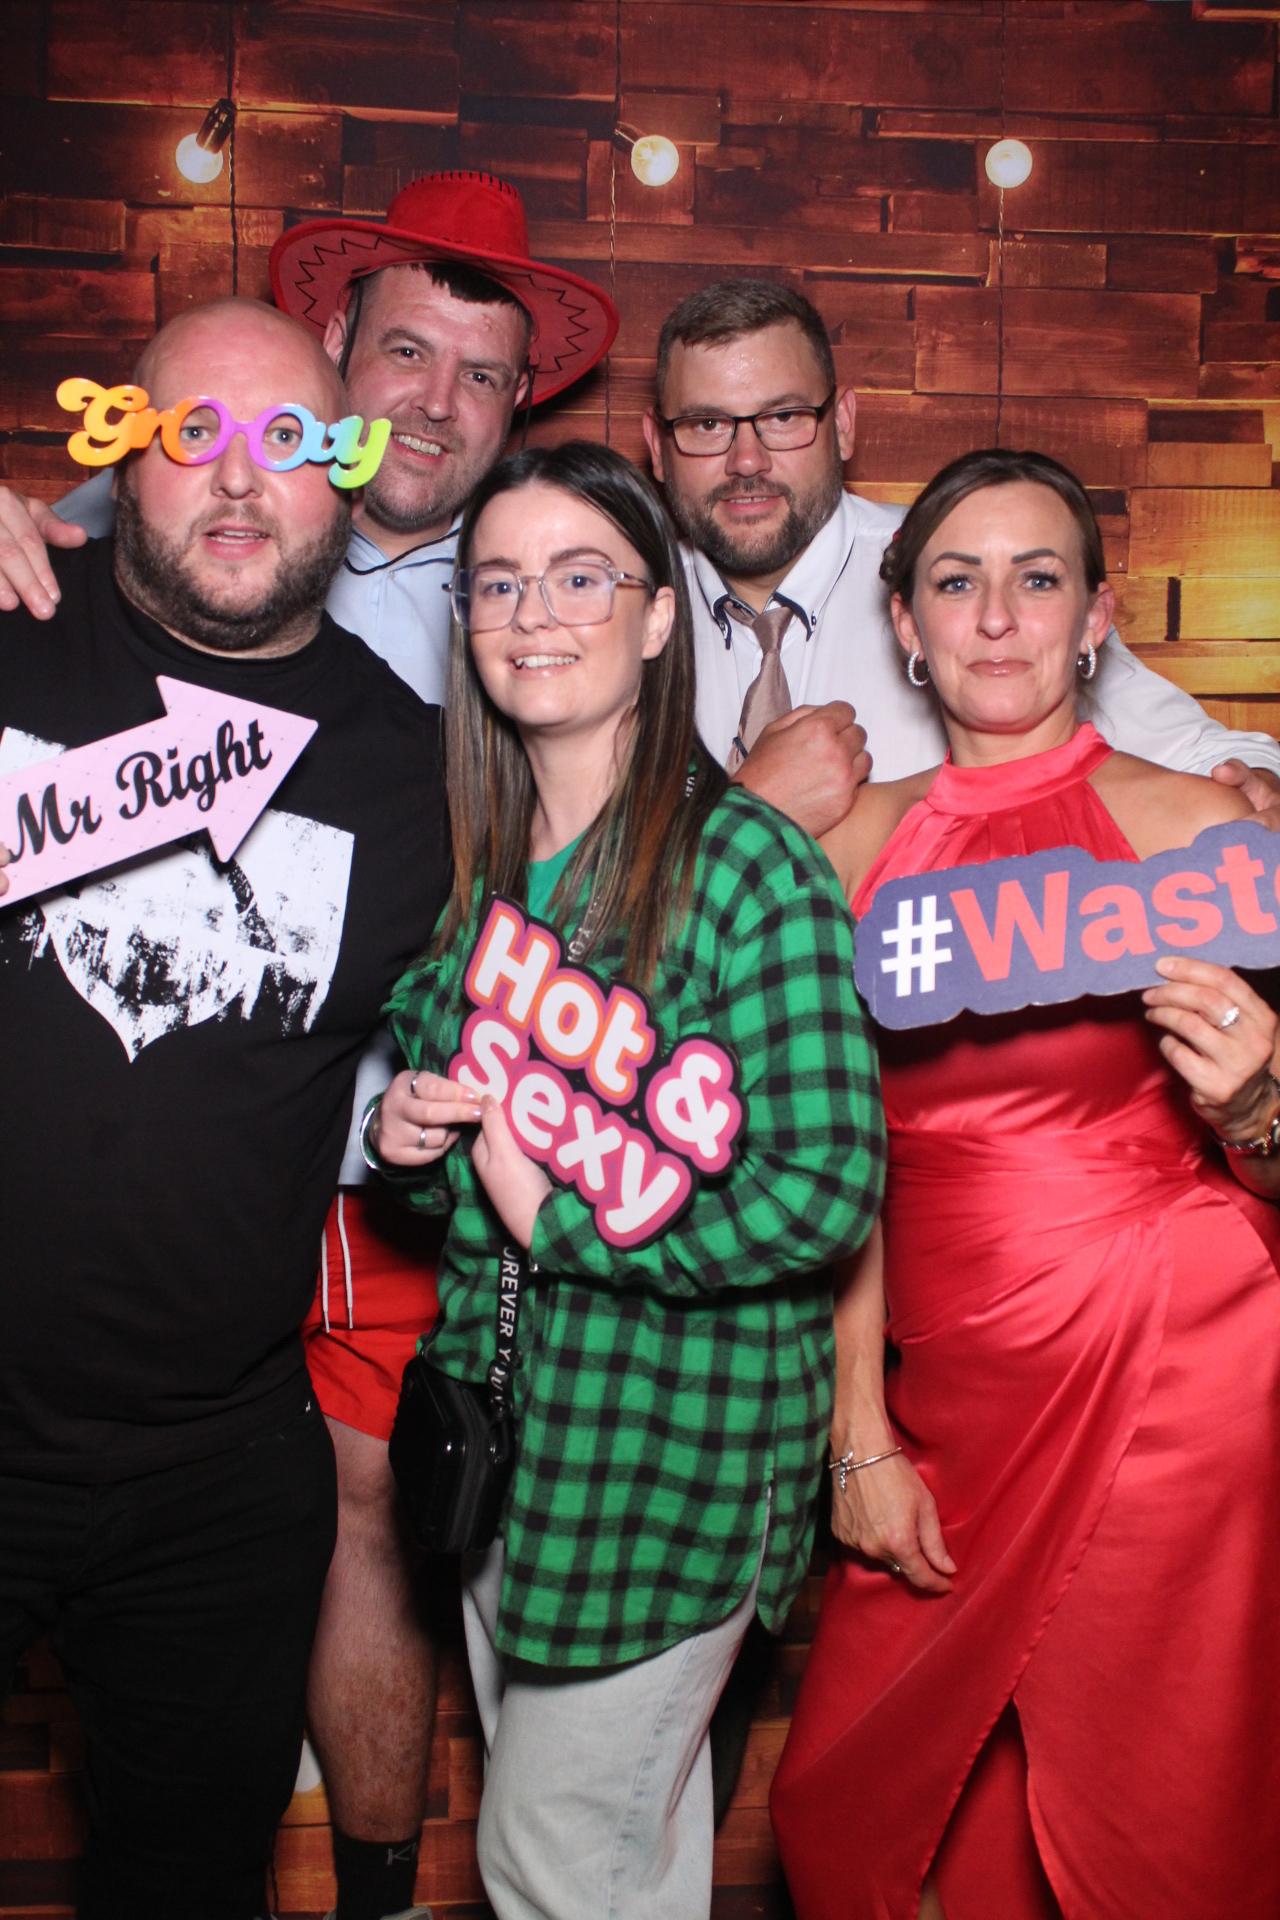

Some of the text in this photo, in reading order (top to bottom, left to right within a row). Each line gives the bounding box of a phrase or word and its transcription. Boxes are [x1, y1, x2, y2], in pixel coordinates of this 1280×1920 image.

[56, 377, 392, 489] Groovy
[8, 719, 273, 864] Mr Right
[880, 844, 1280, 998] #Wast
[472, 912, 731, 1160] Hot &
[457, 1019, 681, 1235] Sexy
